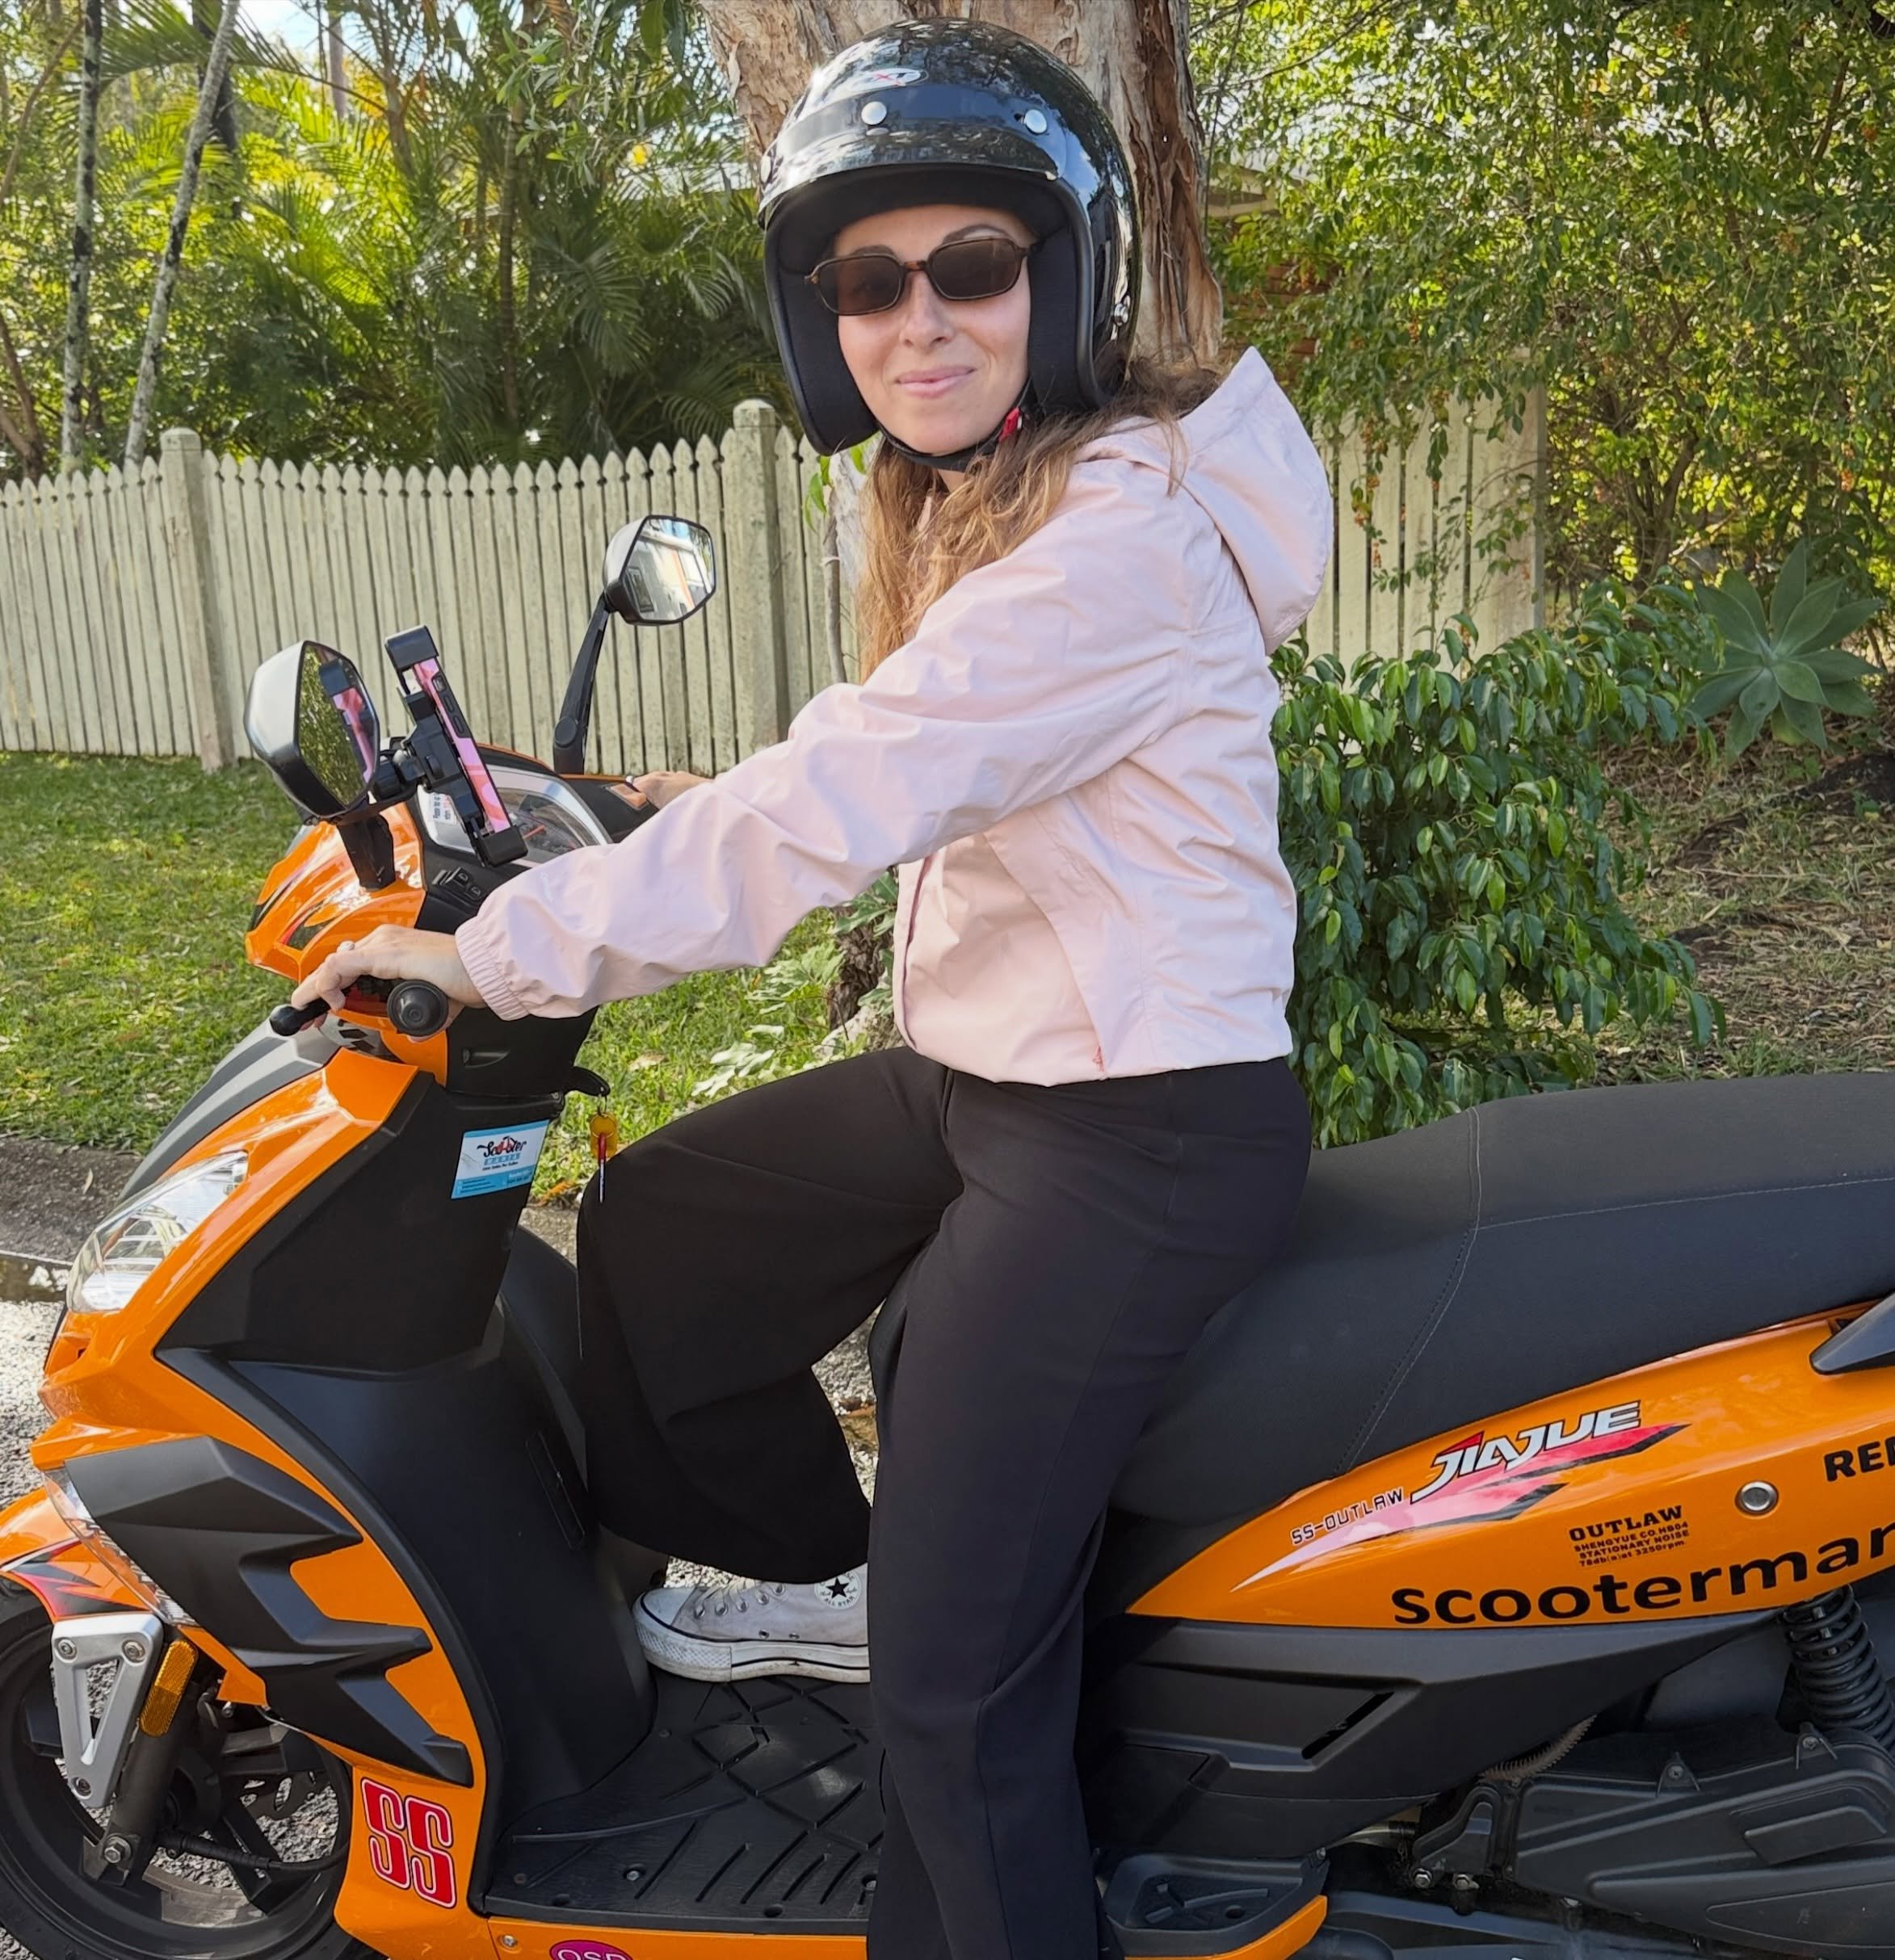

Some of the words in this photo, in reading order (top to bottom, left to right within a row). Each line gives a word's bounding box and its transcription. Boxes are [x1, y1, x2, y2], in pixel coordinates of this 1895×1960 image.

[1410, 1400, 1641, 1505] JIAJUE
[1291, 1488, 1403, 1544] SS-OUTLAW
[1569, 1505, 1683, 1542] OUTLAW
[1574, 1534, 1637, 1552] SHENGYUE
[1579, 1538, 1651, 1559] STATIONARY
[1654, 1530, 1690, 1545] NOISE
[360, 1777, 458, 1910] SS
